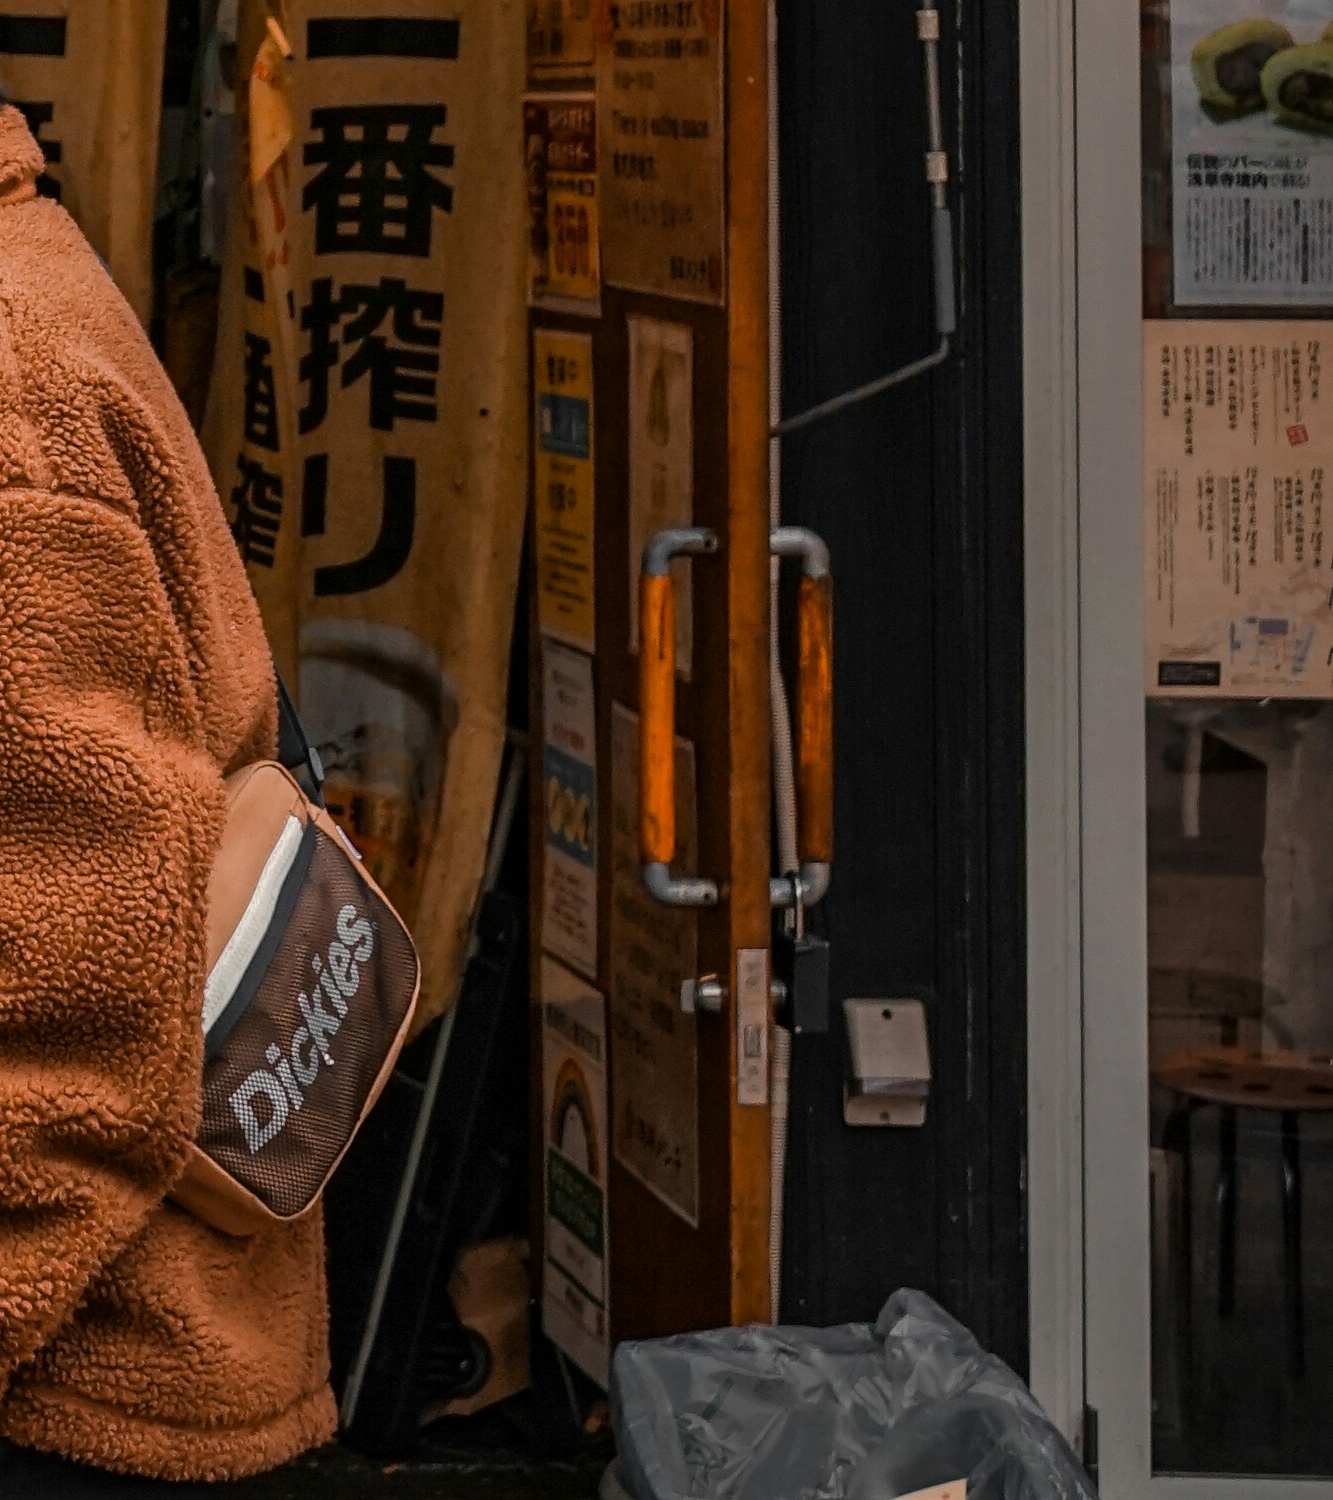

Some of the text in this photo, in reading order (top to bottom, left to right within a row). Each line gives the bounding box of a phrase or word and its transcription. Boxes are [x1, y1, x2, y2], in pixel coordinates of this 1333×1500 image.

[298, 15, 461, 598] 一番搾り
[228, 903, 376, 1156] Dickies
